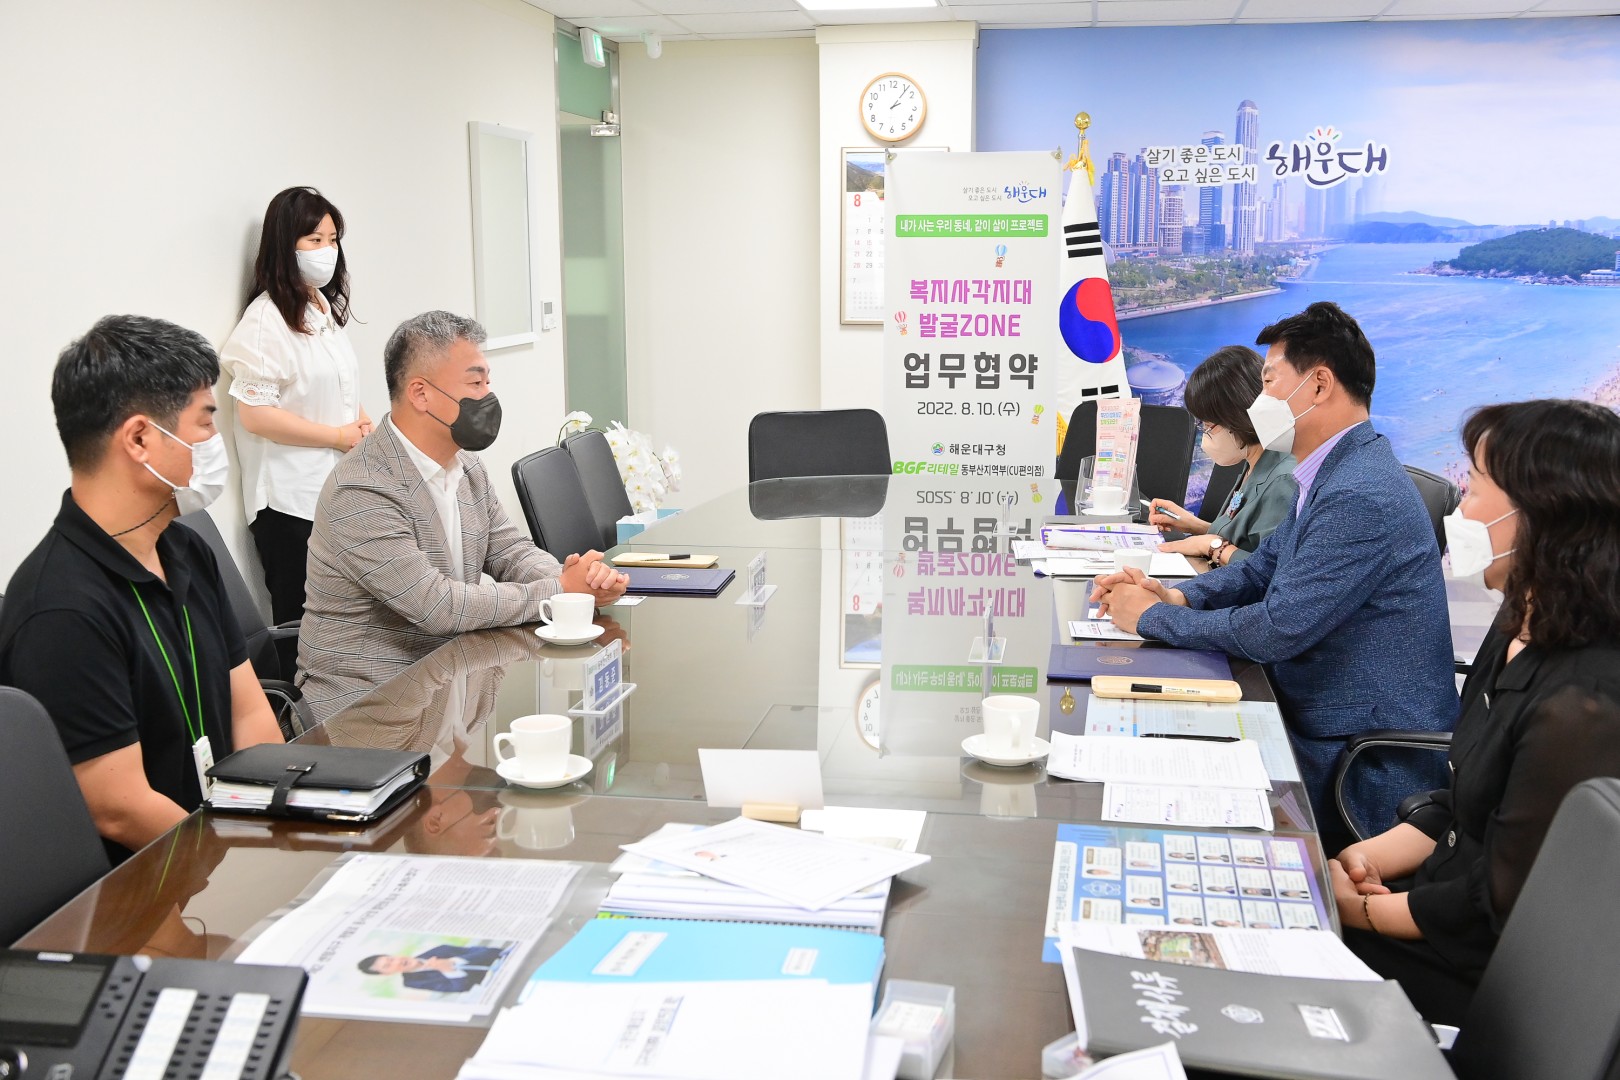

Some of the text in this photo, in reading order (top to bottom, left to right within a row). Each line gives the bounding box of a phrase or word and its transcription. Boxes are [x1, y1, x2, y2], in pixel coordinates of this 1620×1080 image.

[890, 80, 898, 88] 12
[870, 92, 878, 100] 10
[910, 91, 915, 99] 2
[868, 102, 874, 110] 9
[870, 114, 876, 122] 8
[879, 122, 884, 130] 7
[890, 126, 894, 134] 6
[901, 122, 906, 130] 5
[1146, 147, 1241, 164] 살기 좋은 도시
[1266, 142, 1388, 186] 해운대
[1161, 167, 1255, 183] 오고 싶은 도시
[854, 194, 861, 207] 8
[1004, 185, 1047, 203] 해운대
[900, 219, 1044, 232] 내가 사는 우리 동네, 같이 살이 프로젝트
[910, 280, 1032, 304] 복지사각지대
[919, 314, 1021, 338] 발굴ZONE
[903, 352, 1038, 390] 업무협약
[917, 402, 957, 415] 2022.
[949, 444, 1006, 456] 해운대구청
[893, 461, 1045, 477] BGF리테일 동부산지역부(CU편의점)
